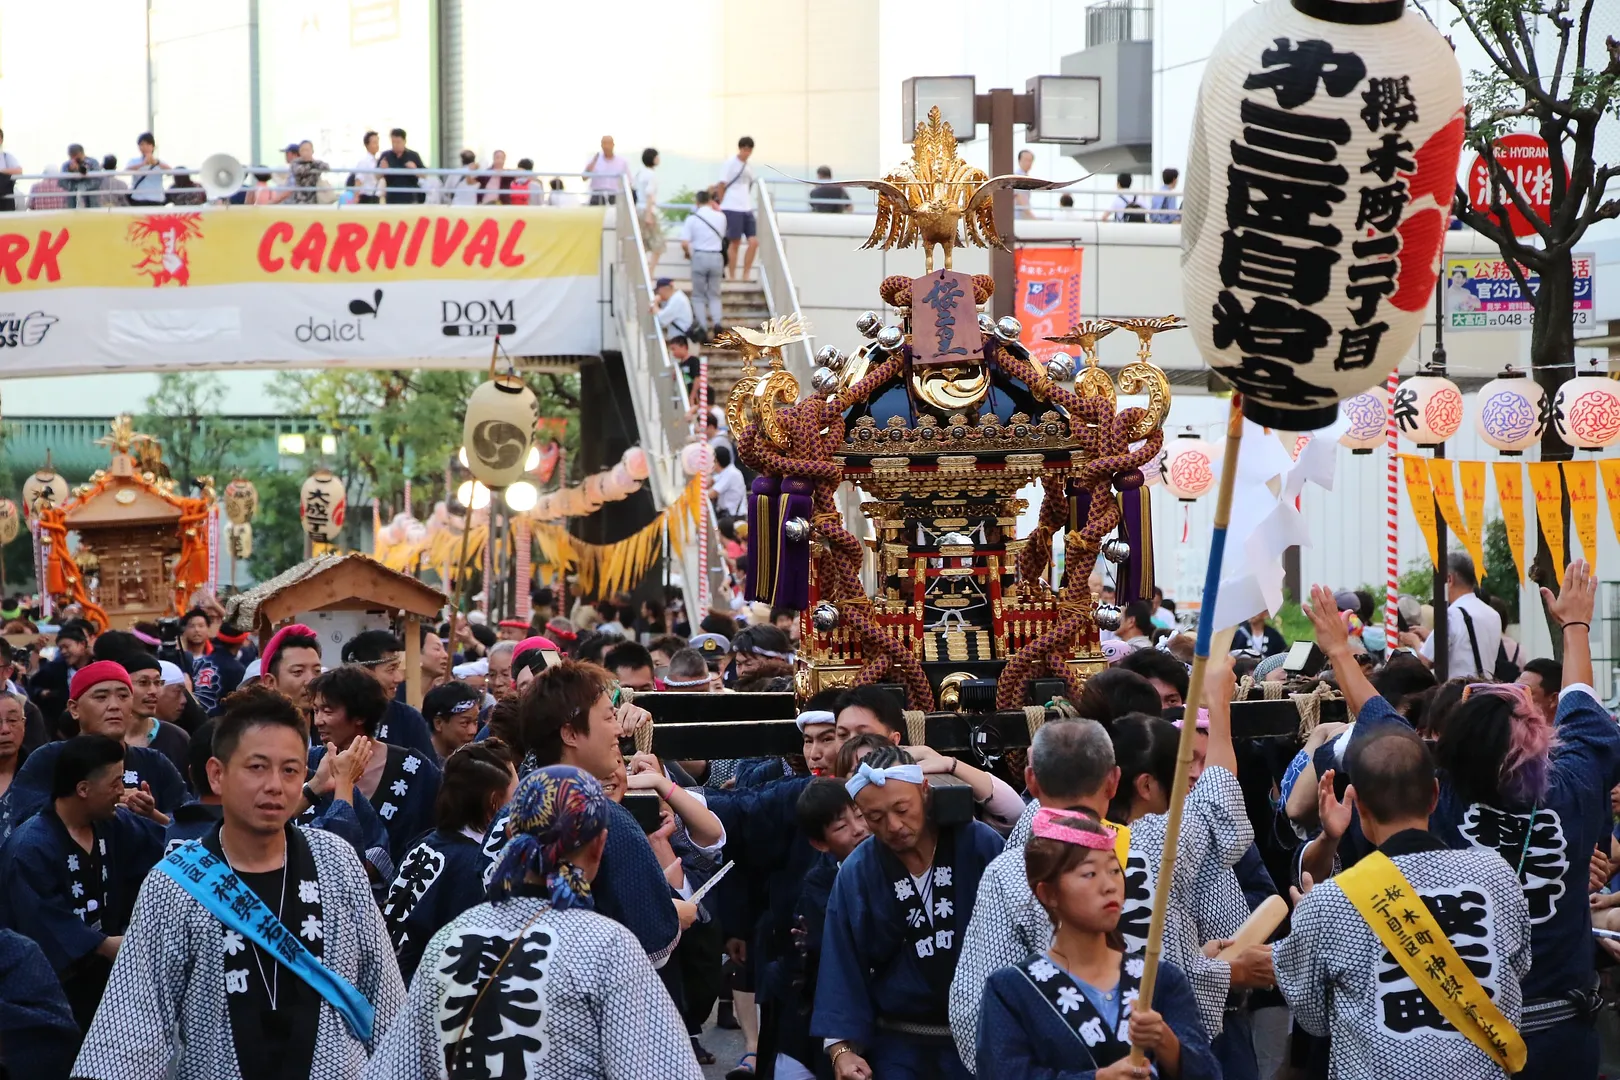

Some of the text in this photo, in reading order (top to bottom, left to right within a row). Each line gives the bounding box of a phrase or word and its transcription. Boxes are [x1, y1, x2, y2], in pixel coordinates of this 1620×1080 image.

[1510, 147, 1549, 158] HYDRAN
[257, 216, 527, 274] CARNIVAL
[441, 299, 516, 324] DOM
[1476, 281, 1589, 298] 官公庁マジ
[1453, 313, 1486, 326] 大宮店
[933, 866, 955, 949] 桜木町
[1370, 894, 1421, 958] 二丁目三区
[1383, 884, 1435, 946] 桜木町
[1028, 958, 1106, 1047] 桜木町
